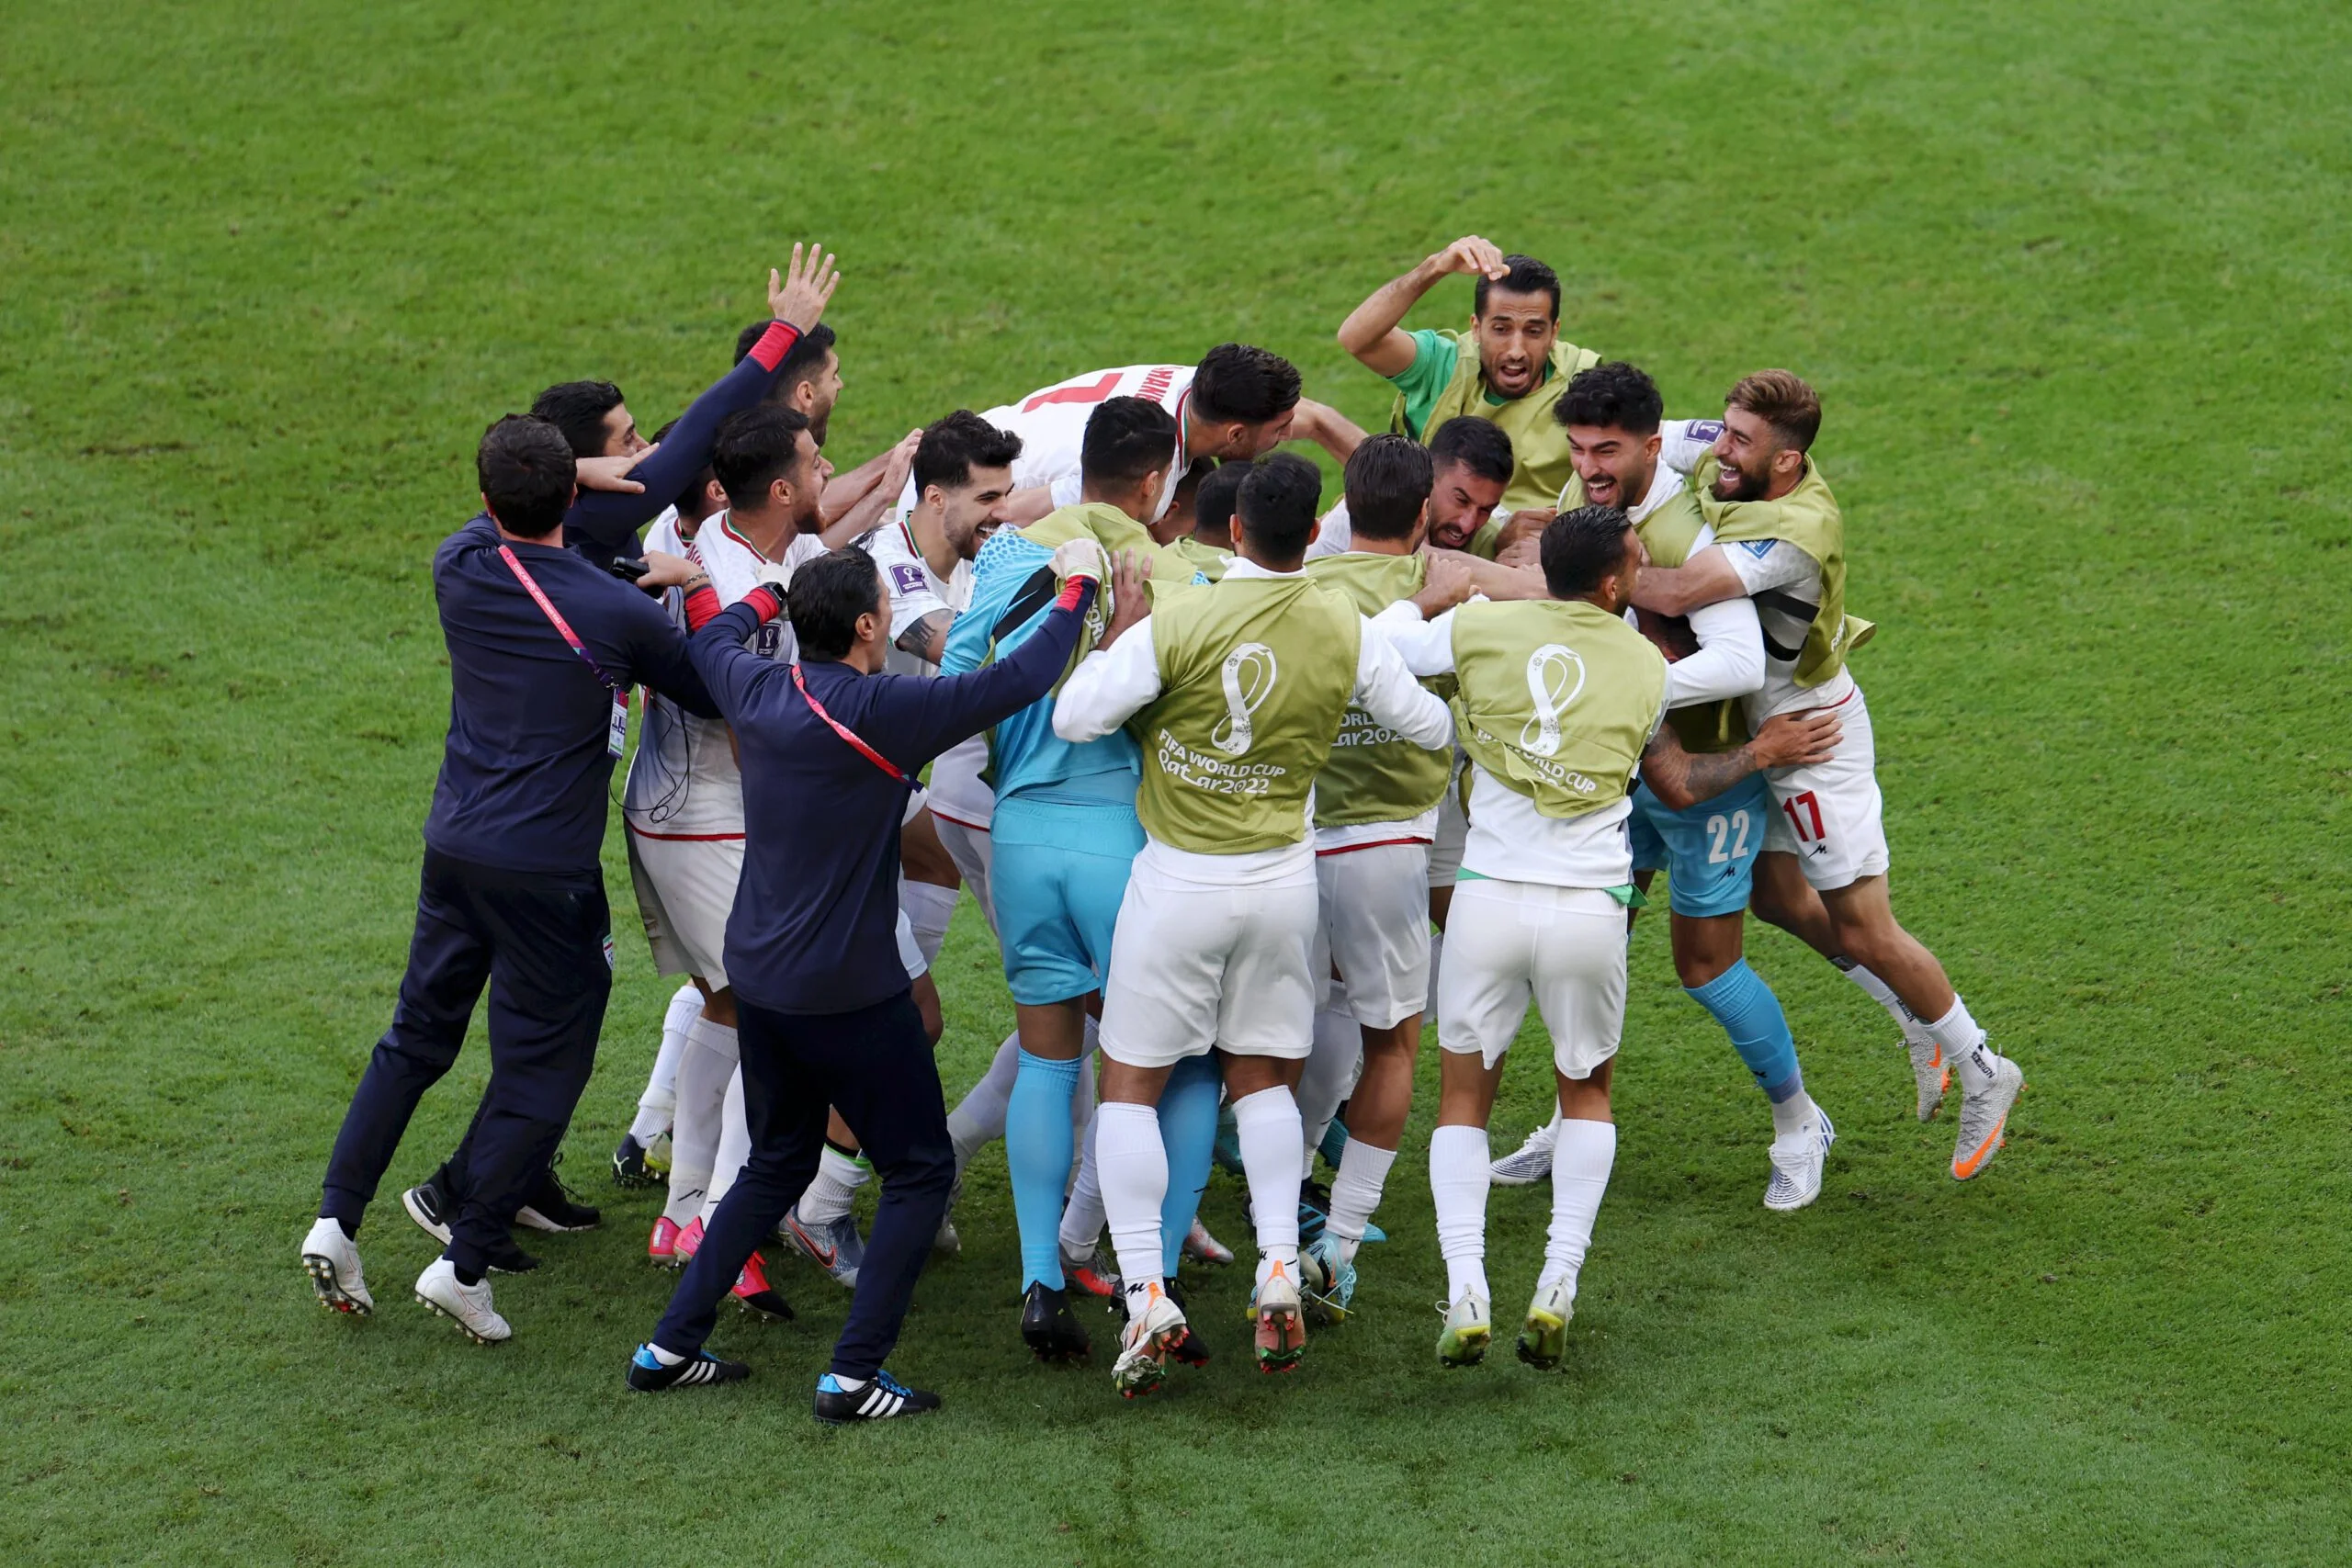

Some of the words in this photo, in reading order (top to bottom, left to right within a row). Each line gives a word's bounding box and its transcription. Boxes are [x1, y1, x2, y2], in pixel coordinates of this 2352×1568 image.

[1340, 712, 1375, 728] ORL
[1159, 728, 1186, 761] FIFA
[1189, 750, 1251, 778] WORLD
[1251, 763, 1285, 777] CUP
[1565, 772, 1597, 794] CUP
[1706, 809, 1750, 864] 22
[1782, 790, 1826, 842] 17
